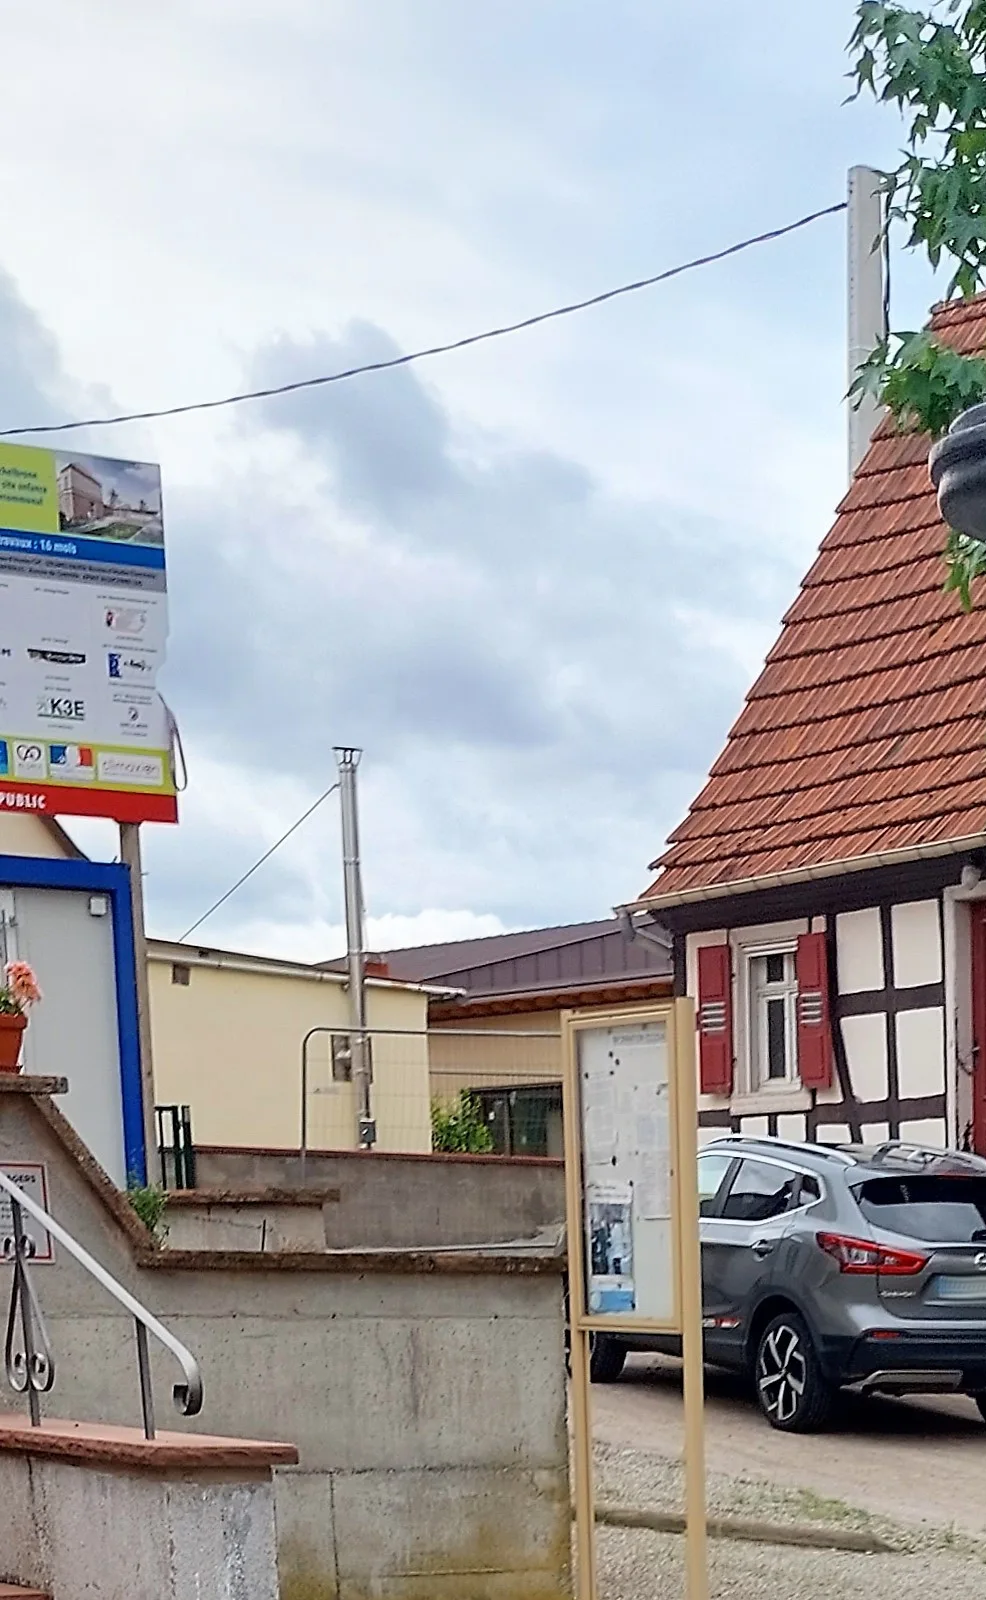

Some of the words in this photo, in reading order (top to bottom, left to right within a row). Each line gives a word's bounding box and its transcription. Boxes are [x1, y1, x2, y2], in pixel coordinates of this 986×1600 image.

[40, 539, 52, 551] 16
[53, 542, 77, 555] mois
[50, 698, 84, 717] K3E
[0, 791, 47, 809] PUBLIC
